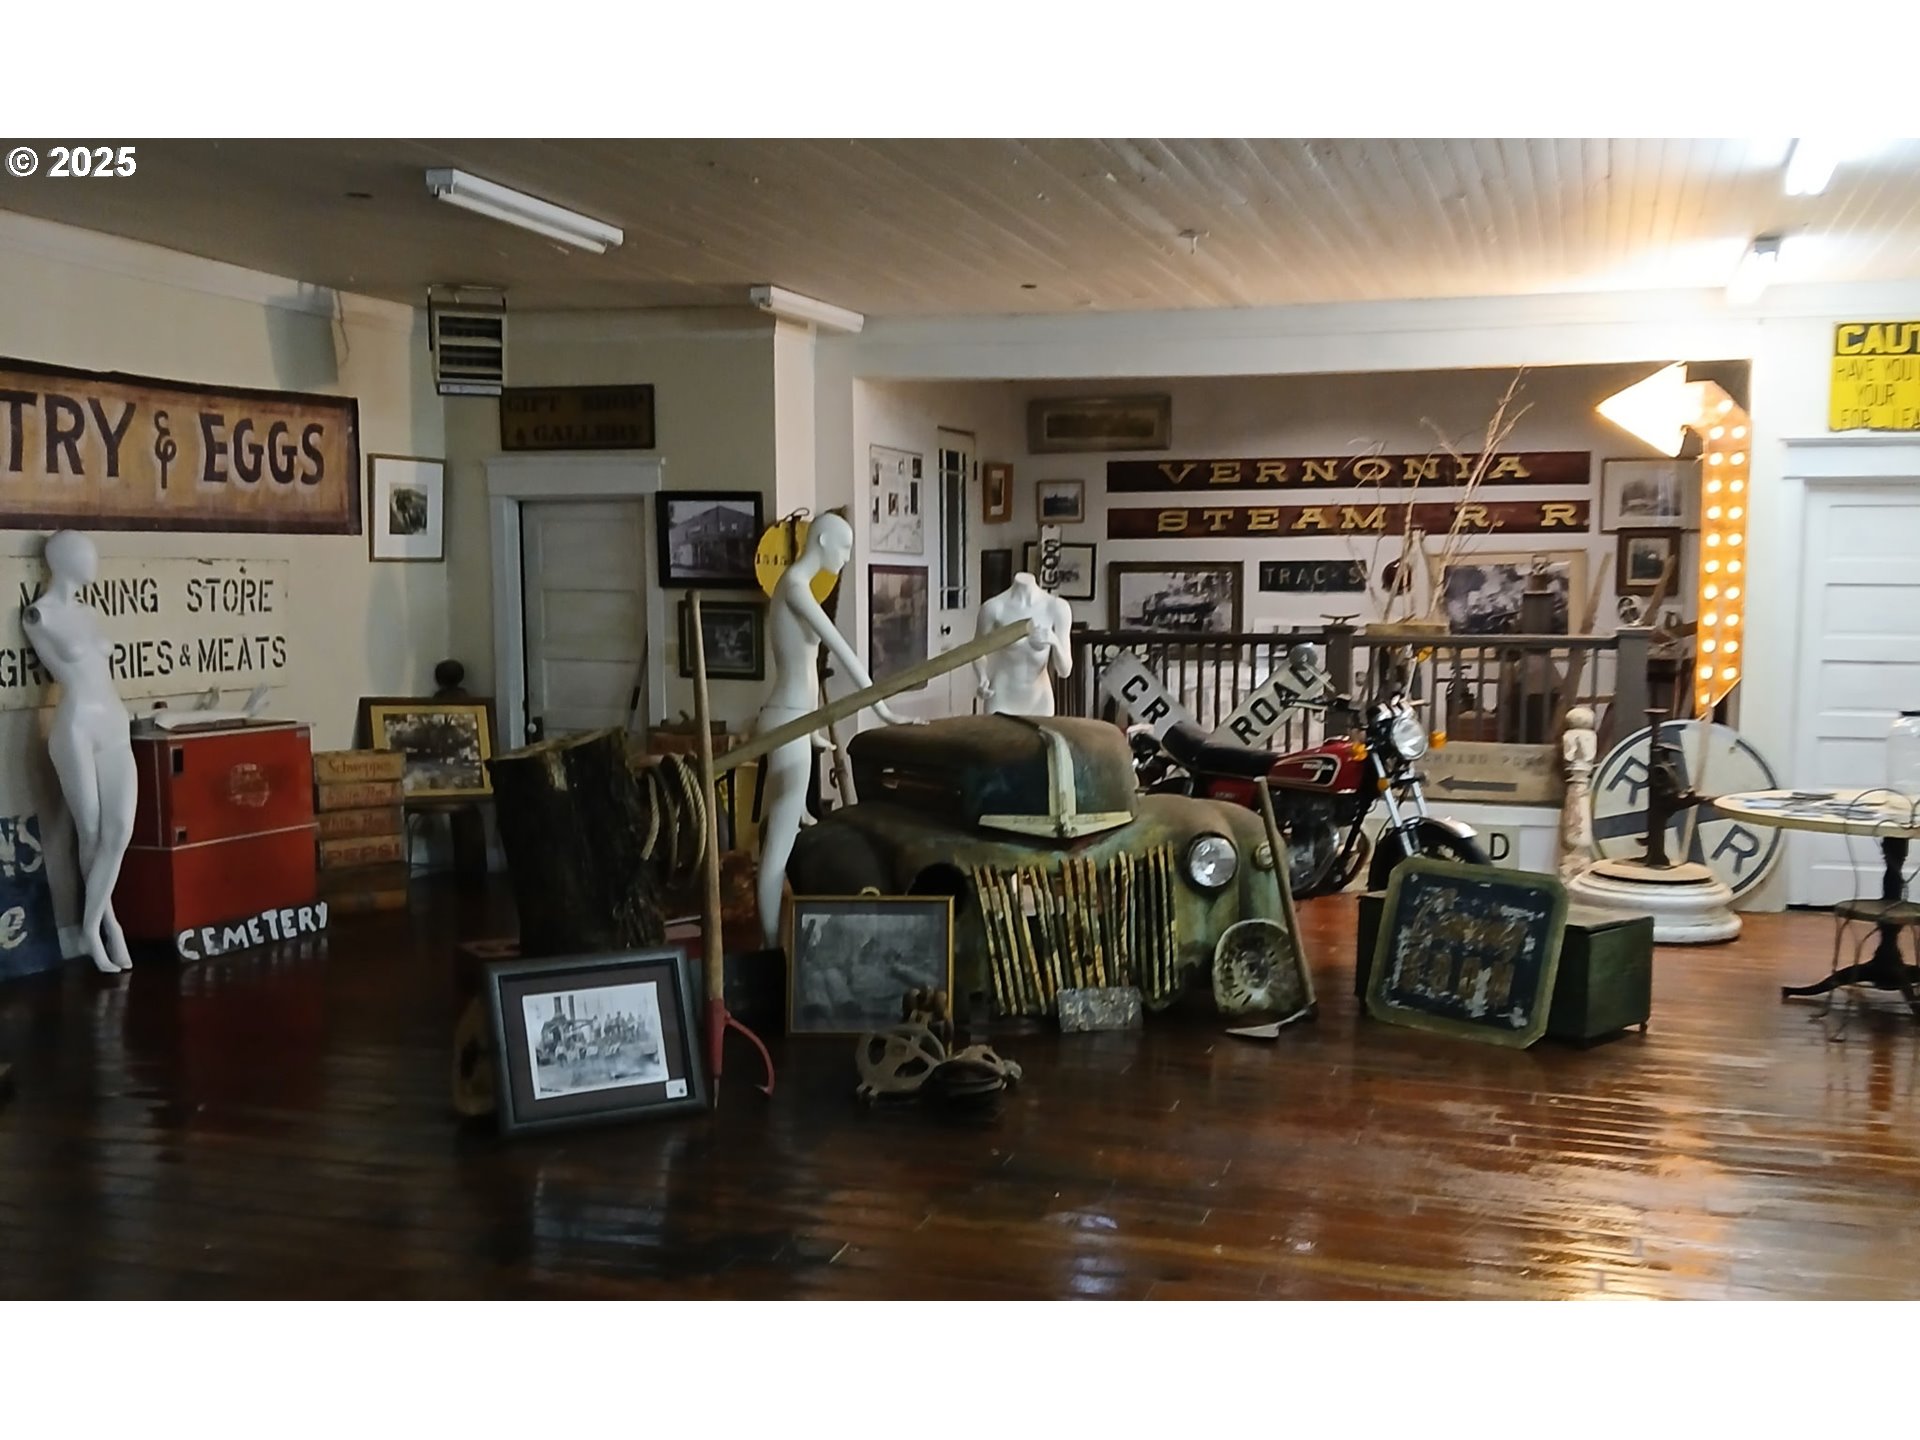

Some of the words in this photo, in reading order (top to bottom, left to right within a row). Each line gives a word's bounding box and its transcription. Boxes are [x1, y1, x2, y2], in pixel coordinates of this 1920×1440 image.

[0, 390, 136, 478] TRY
[154, 409, 177, 490] &
[199, 412, 325, 485] EGGS
[1158, 455, 1531, 485] VERNONIA
[1158, 505, 1387, 535] STEAM
[1264, 566, 1361, 585] TRACS
[186, 577, 274, 614] STORE
[0, 640, 174, 688] GRRIES
[179, 643, 192, 667] &
[198, 636, 287, 673] MEATS
[326, 843, 400, 865] PEPSI
[1489, 833, 1510, 861] D
[1710, 823, 1760, 877] R
[177, 901, 328, 960] CEMETERY
